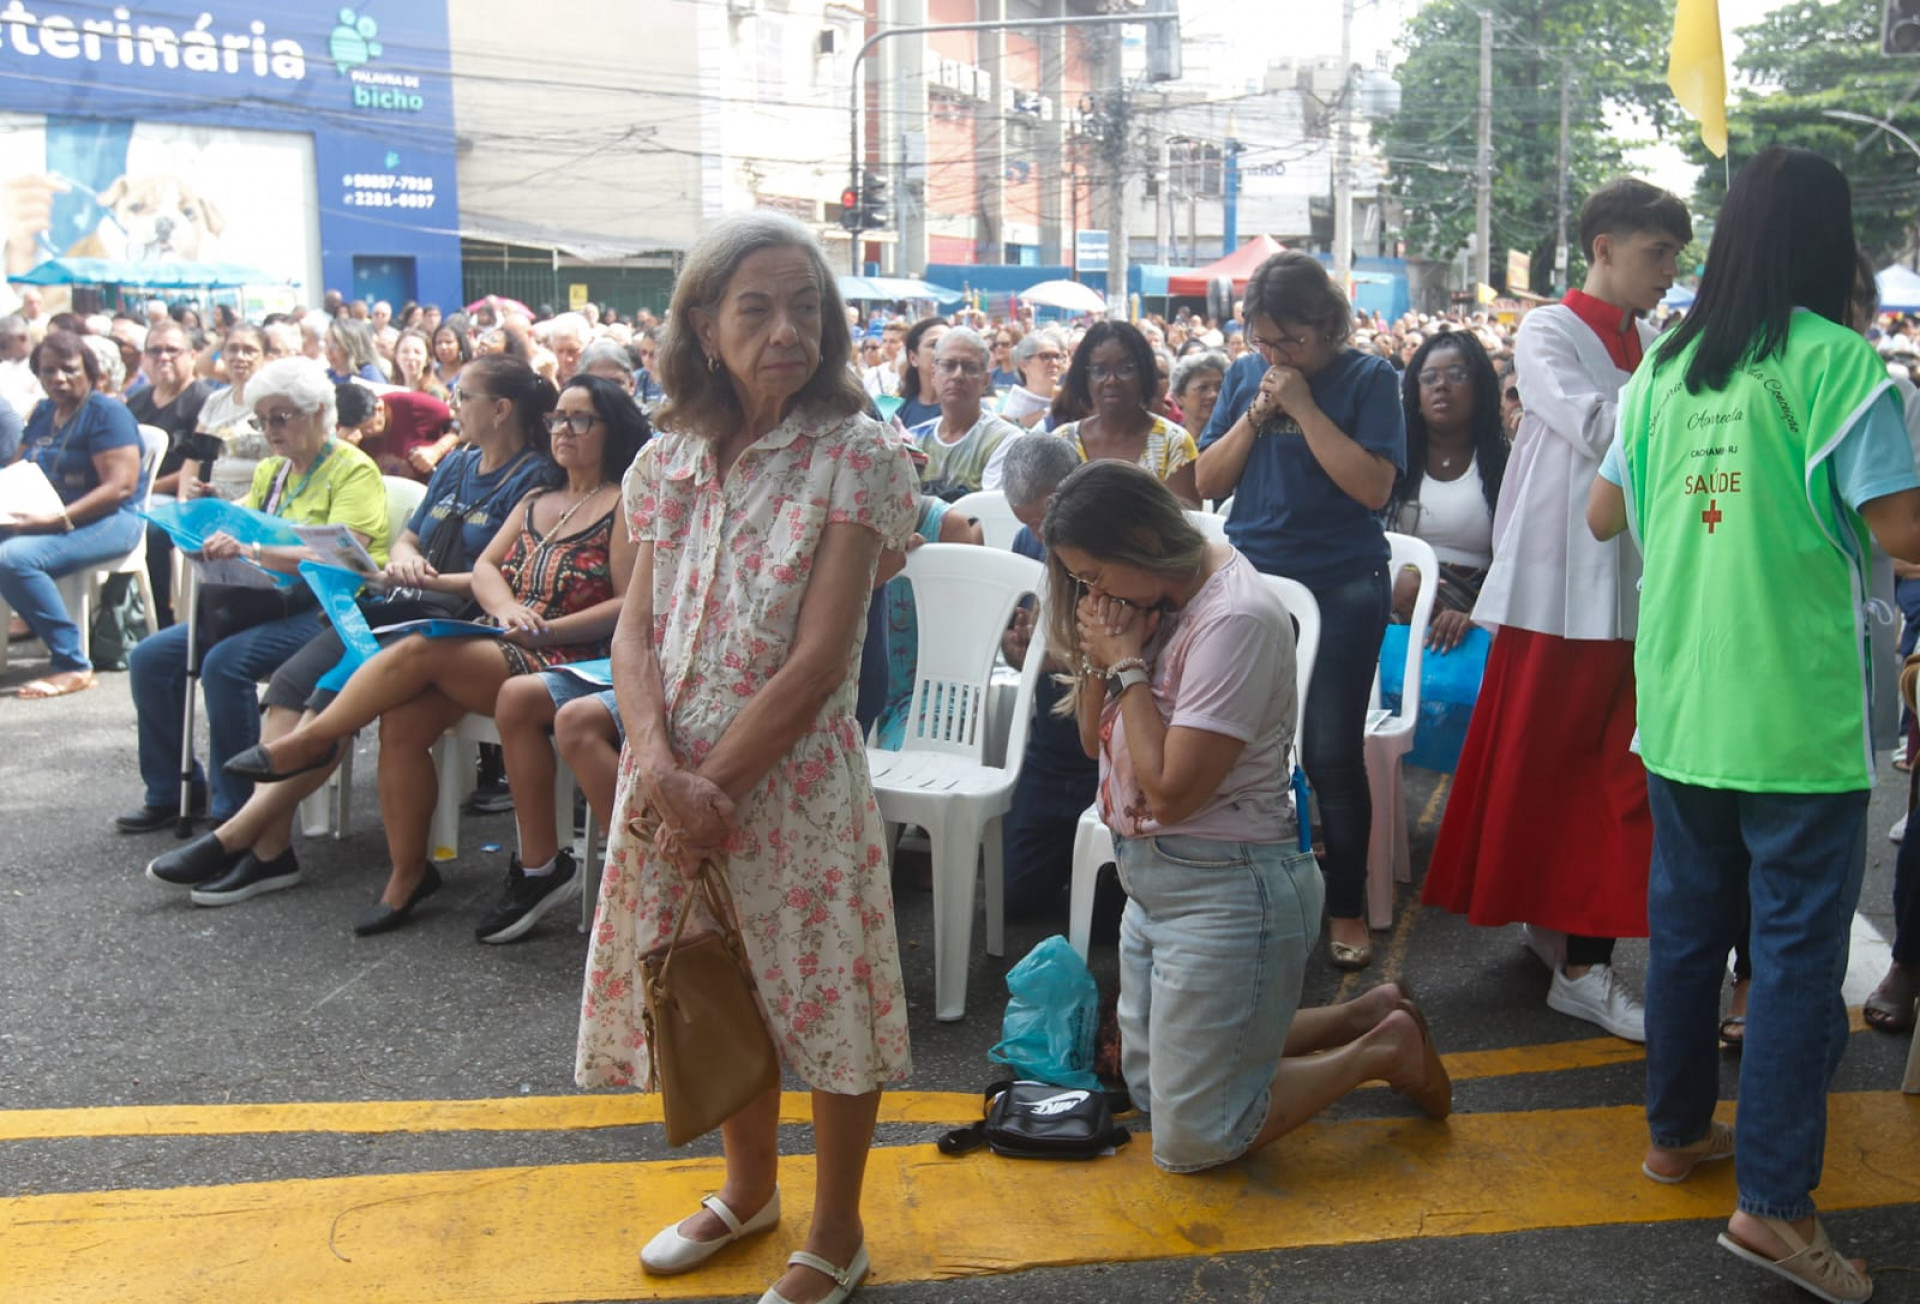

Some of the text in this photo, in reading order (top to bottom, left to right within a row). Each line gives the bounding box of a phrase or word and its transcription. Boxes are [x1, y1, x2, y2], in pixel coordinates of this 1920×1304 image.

[0, 0, 306, 79] terinária
[353, 85, 424, 111] bicho
[1684, 467, 1742, 495] SAÚDE
